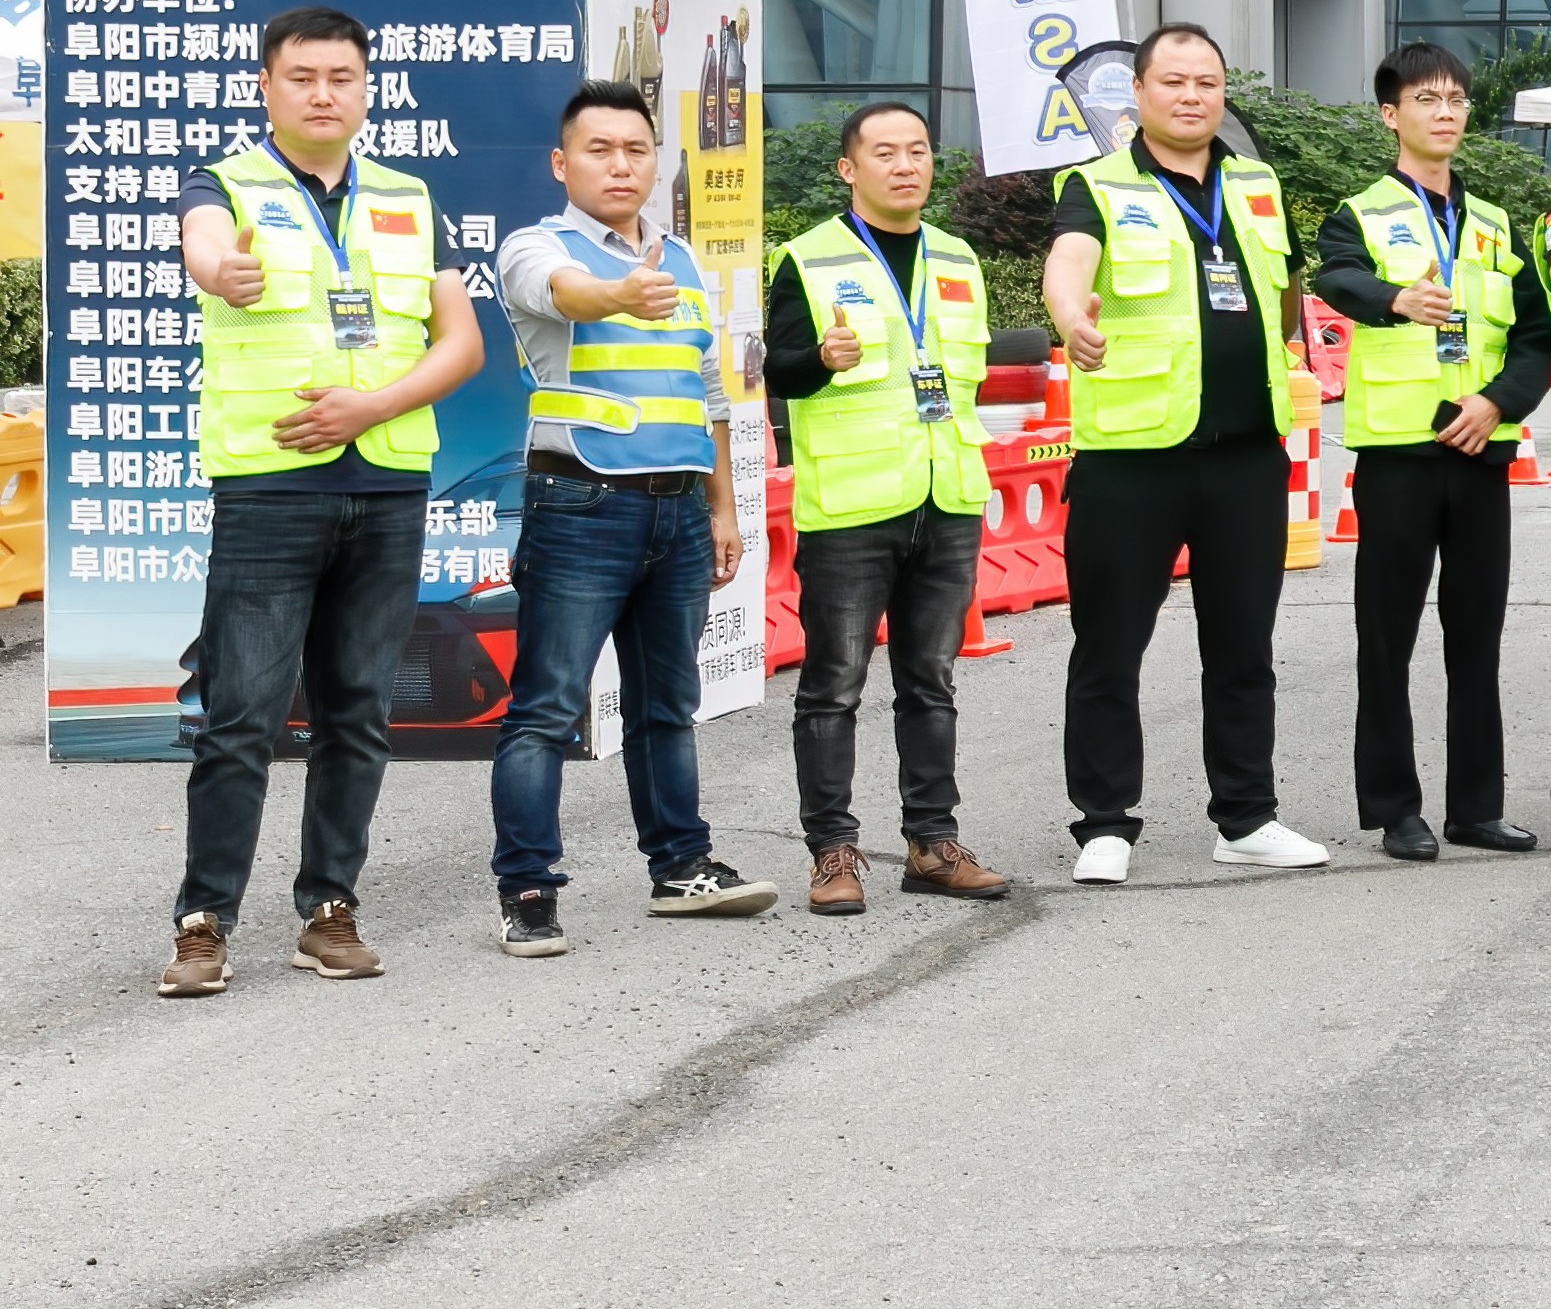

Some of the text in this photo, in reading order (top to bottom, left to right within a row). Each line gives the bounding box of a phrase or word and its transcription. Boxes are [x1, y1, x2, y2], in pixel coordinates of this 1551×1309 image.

[64, 165, 202, 204] 支持单
[704, 168, 745, 190] 奥迪专用
